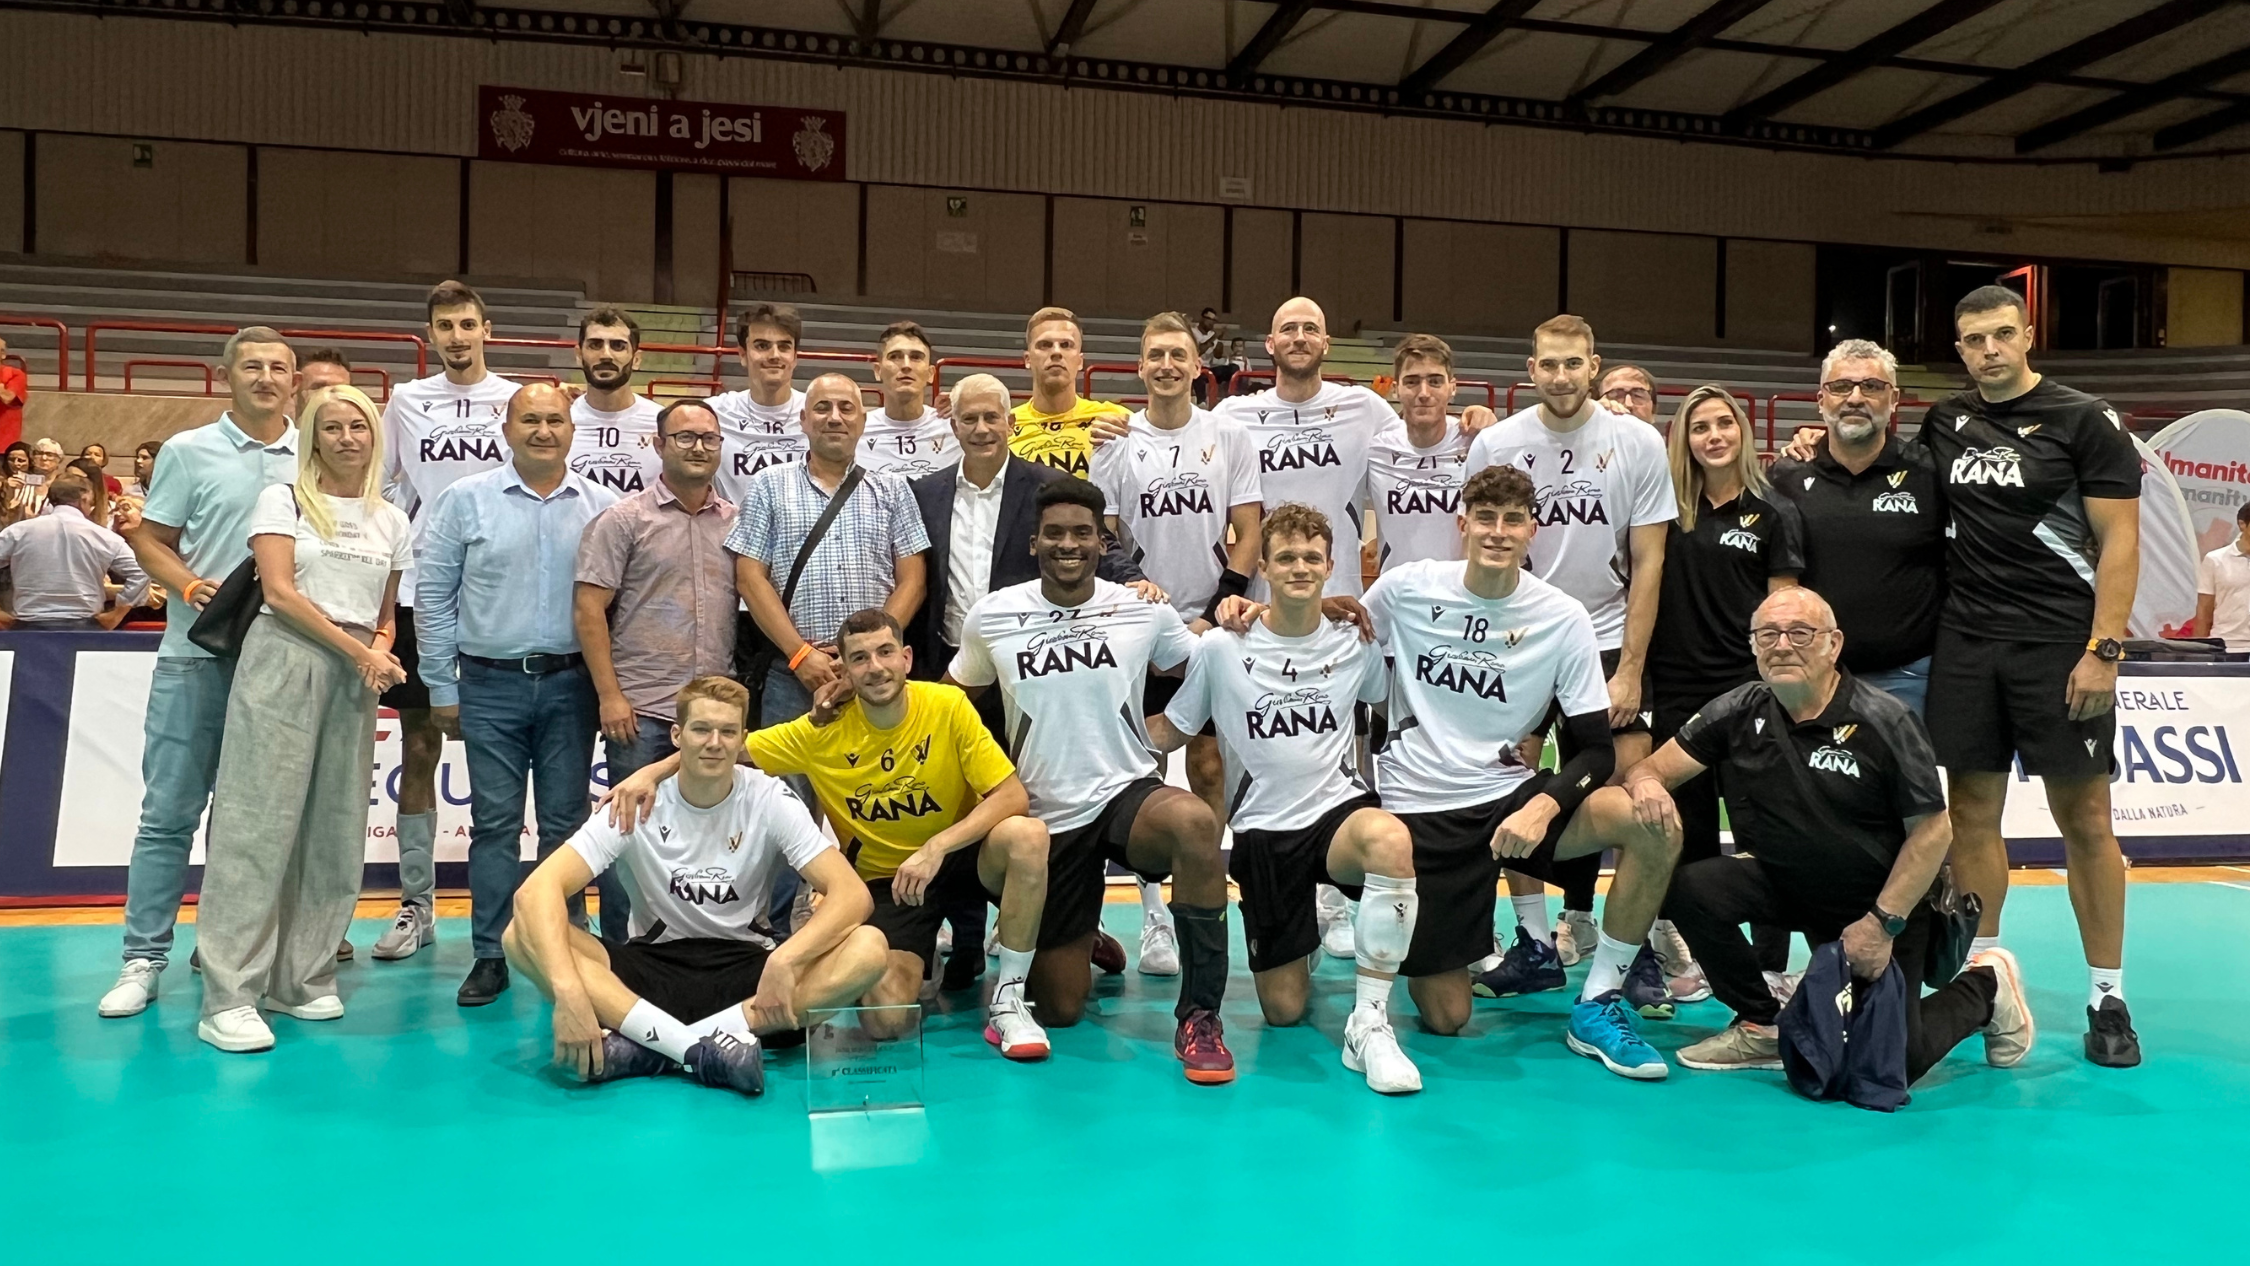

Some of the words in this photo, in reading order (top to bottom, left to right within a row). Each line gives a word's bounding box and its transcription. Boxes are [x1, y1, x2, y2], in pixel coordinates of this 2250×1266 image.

[570, 102, 658, 142] vjeni
[669, 114, 690, 138] a
[694, 109, 762, 148] jesi
[456, 399, 470, 418] 11
[420, 438, 504, 462] RANA
[596, 427, 620, 448] 10
[895, 435, 917, 455] 13
[734, 453, 804, 475] RAN
[1169, 445, 1179, 468] 7
[1259, 443, 1341, 473] RANA
[1560, 449, 1574, 474] 2
[2154, 449, 2250, 484] manit
[586, 468, 645, 492] ANA
[1950, 458, 2025, 487] RANA
[1140, 488, 1214, 518] RANA
[1532, 499, 1609, 526] RANA
[1872, 498, 1918, 514] RANA
[1463, 614, 1489, 643] 18
[1016, 642, 1118, 680] RANA
[1281, 658, 1298, 682] 4
[1416, 654, 1507, 704] RANA
[1246, 705, 1338, 740] RANA
[880, 748, 895, 772] 6
[1809, 751, 1860, 778] RANA
[845, 789, 943, 822] RANA
[2113, 808, 2146, 820] DALLA
[2147, 803, 2188, 819] NATURA
